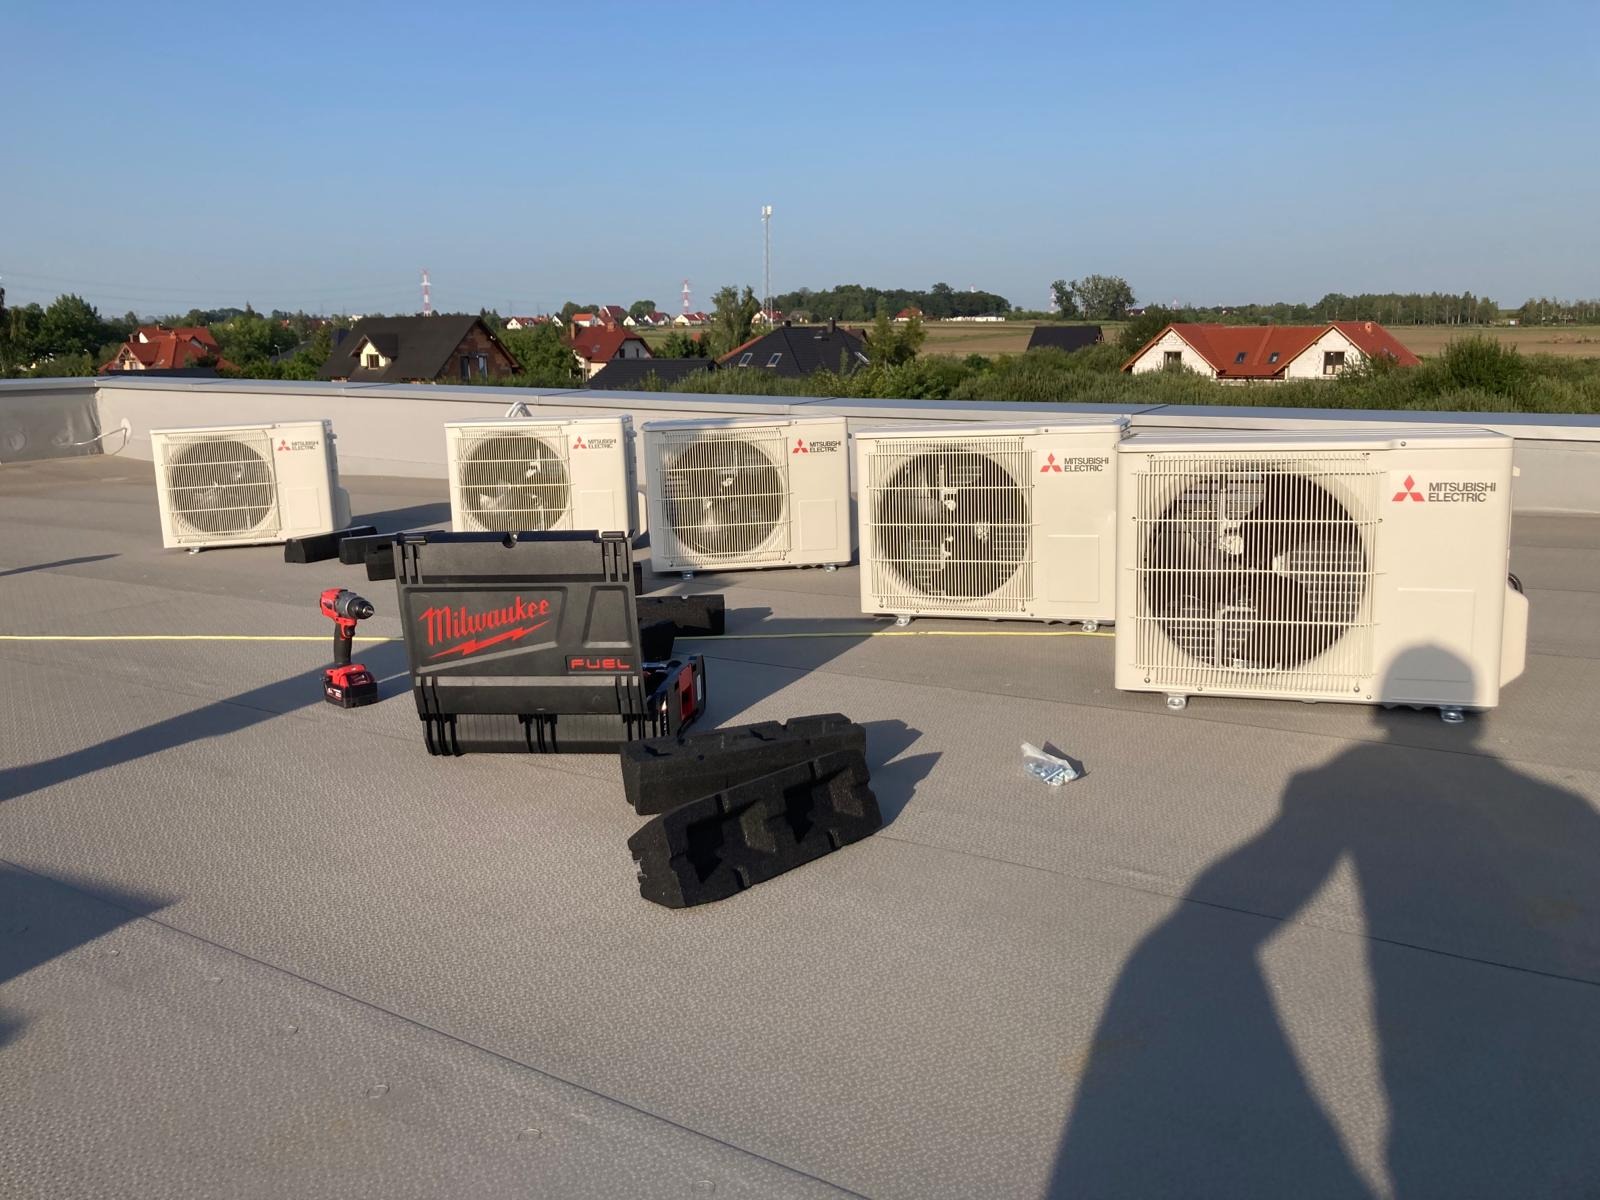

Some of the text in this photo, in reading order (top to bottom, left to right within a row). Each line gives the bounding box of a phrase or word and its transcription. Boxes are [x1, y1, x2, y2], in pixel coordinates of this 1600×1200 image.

[1064, 457, 1109, 465] MITSUBISHI
[1428, 482, 1496, 492] MITSUBISHI
[1428, 492, 1487, 502] ELECTRIC
[418, 595, 550, 646] Milwaukee
[570, 658, 630, 670] FUEL
